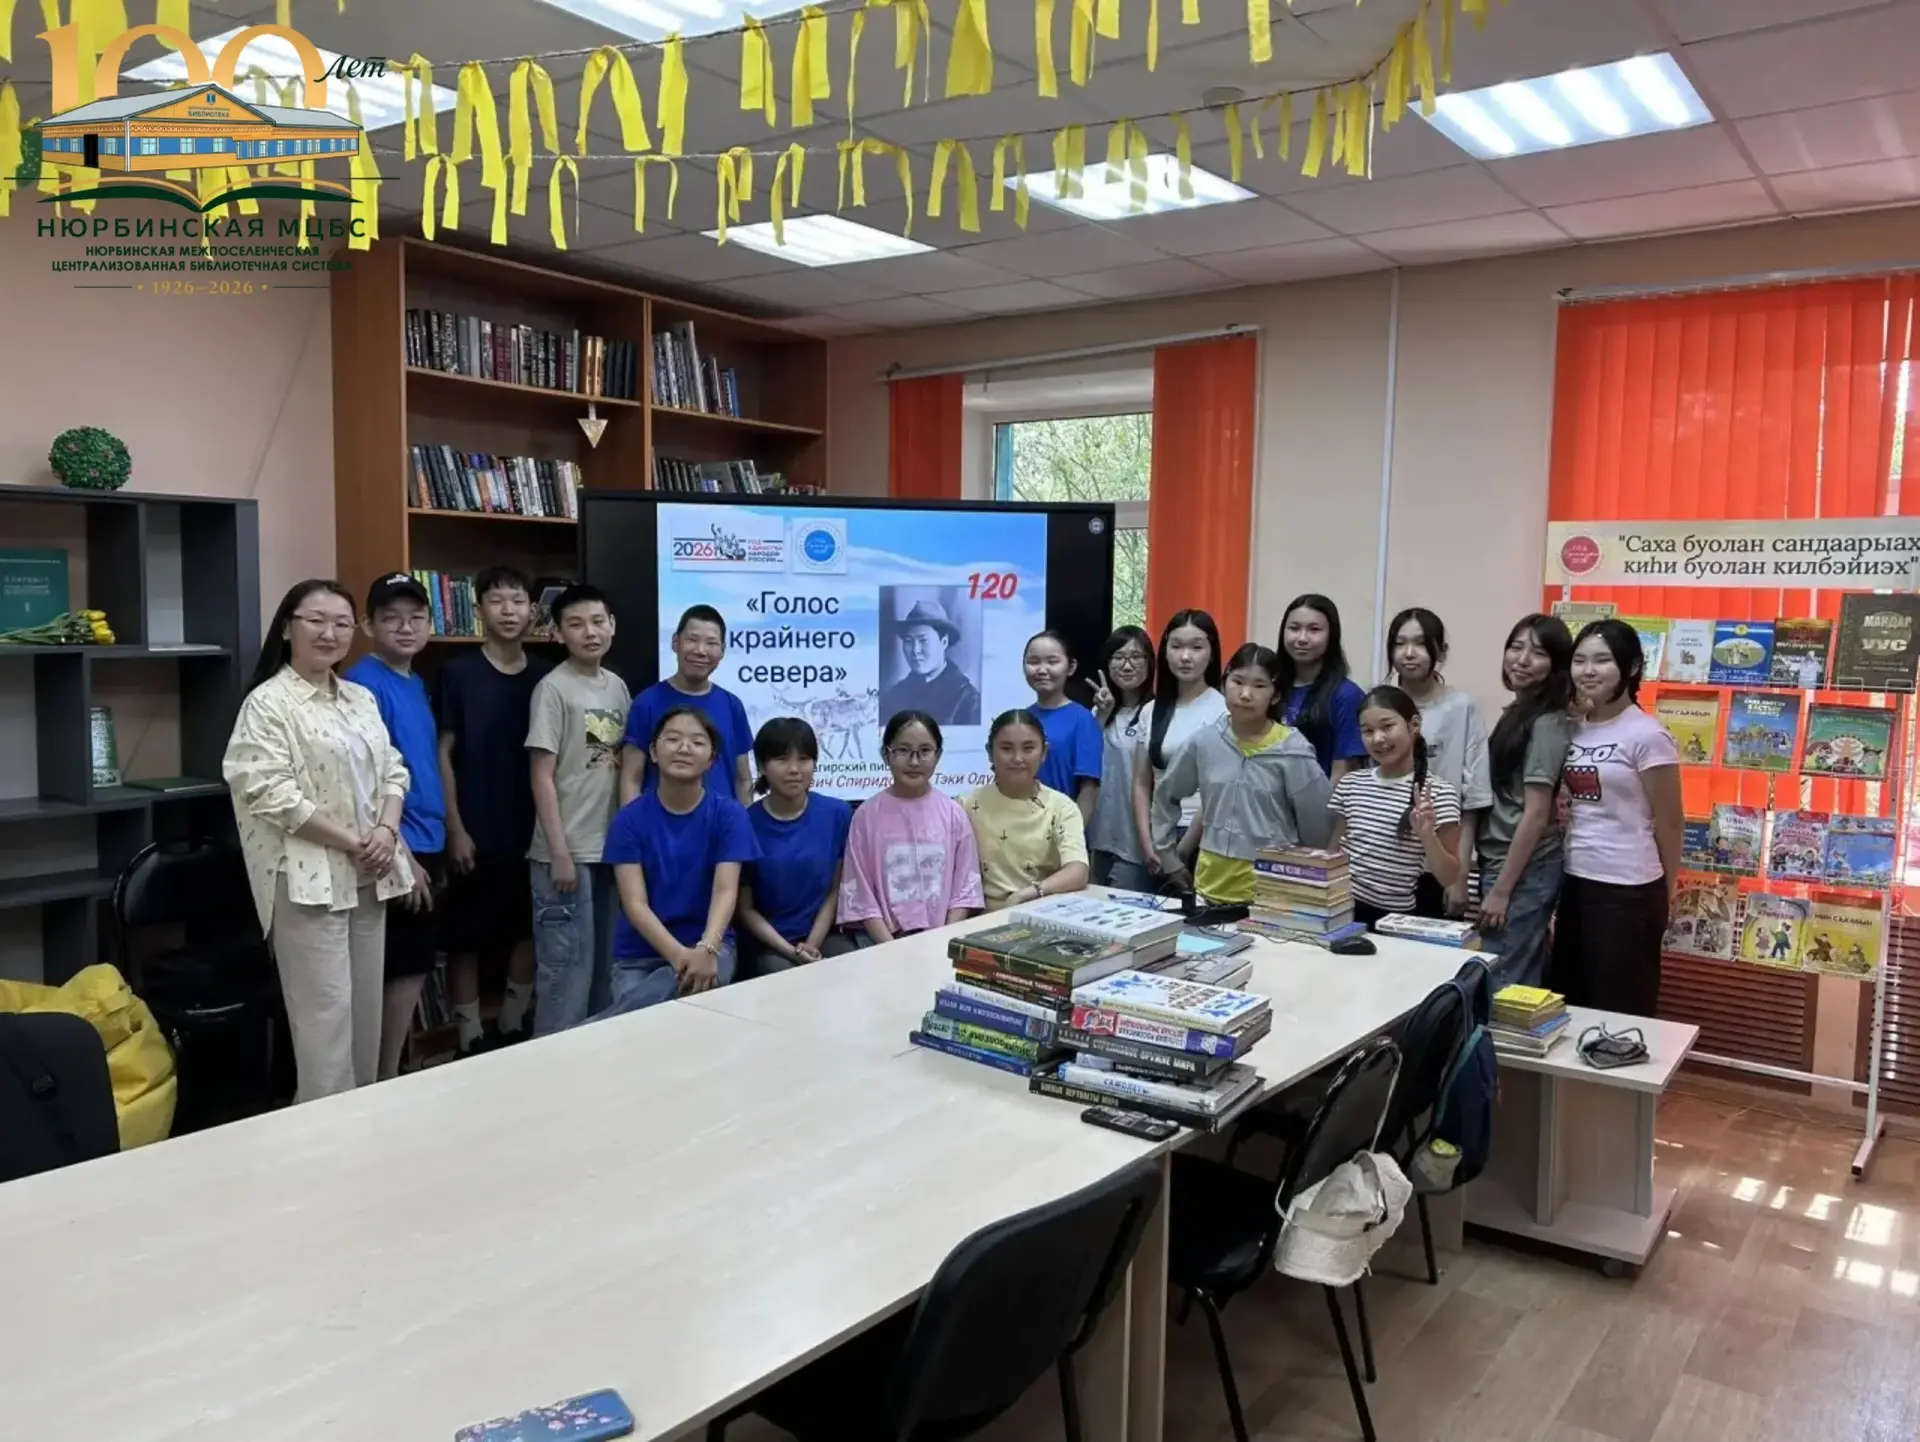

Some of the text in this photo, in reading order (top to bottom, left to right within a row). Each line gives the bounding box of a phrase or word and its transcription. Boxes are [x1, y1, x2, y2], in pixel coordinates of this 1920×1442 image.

[673, 542, 713, 557] 2026
[1619, 534, 1920, 560] "Саха буолан сандаарыах
[1624, 556, 1919, 580] киһи буолан килбэйиэх"
[967, 573, 1018, 599] 120
[746, 592, 840, 615] «Голос
[1864, 616, 1911, 628] МАНДАР
[730, 627, 855, 652] крайнего
[1862, 639, 1907, 651] УУС
[738, 665, 847, 688] севера»
[935, 773, 964, 784] Тэки
